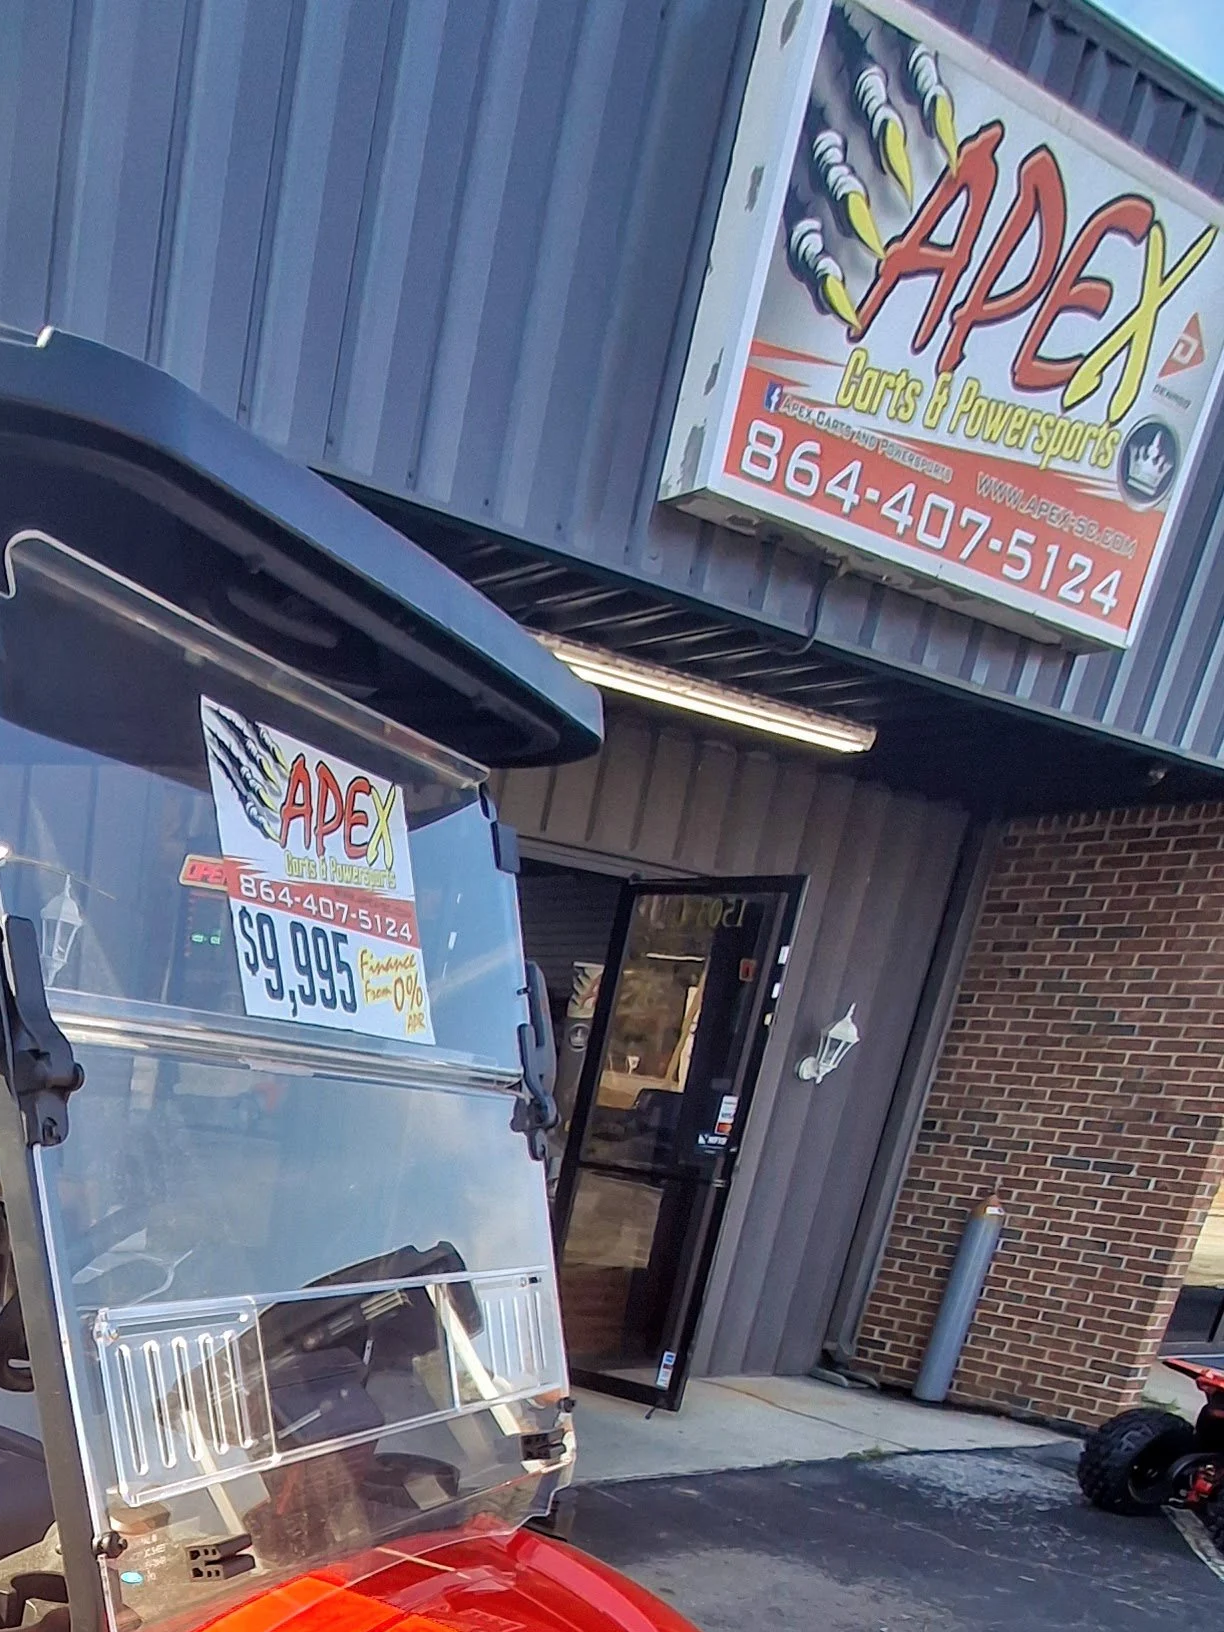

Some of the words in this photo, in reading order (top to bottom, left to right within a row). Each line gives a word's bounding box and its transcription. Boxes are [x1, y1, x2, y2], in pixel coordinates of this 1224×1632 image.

[847, 119, 1219, 426] APEX
[835, 347, 924, 424] Carts
[922, 371, 954, 430] &
[947, 376, 1122, 470] Powersports
[741, 419, 1122, 616] 864-407-5124
[279, 752, 396, 870] APEX
[239, 874, 413, 942] 864-407-5124
[284, 850, 317, 880] Carts
[329, 856, 396, 890] Powersports
[238, 905, 358, 1018] $9,995
[360, 948, 417, 980] Finance
[393, 973, 424, 1013] 0%
